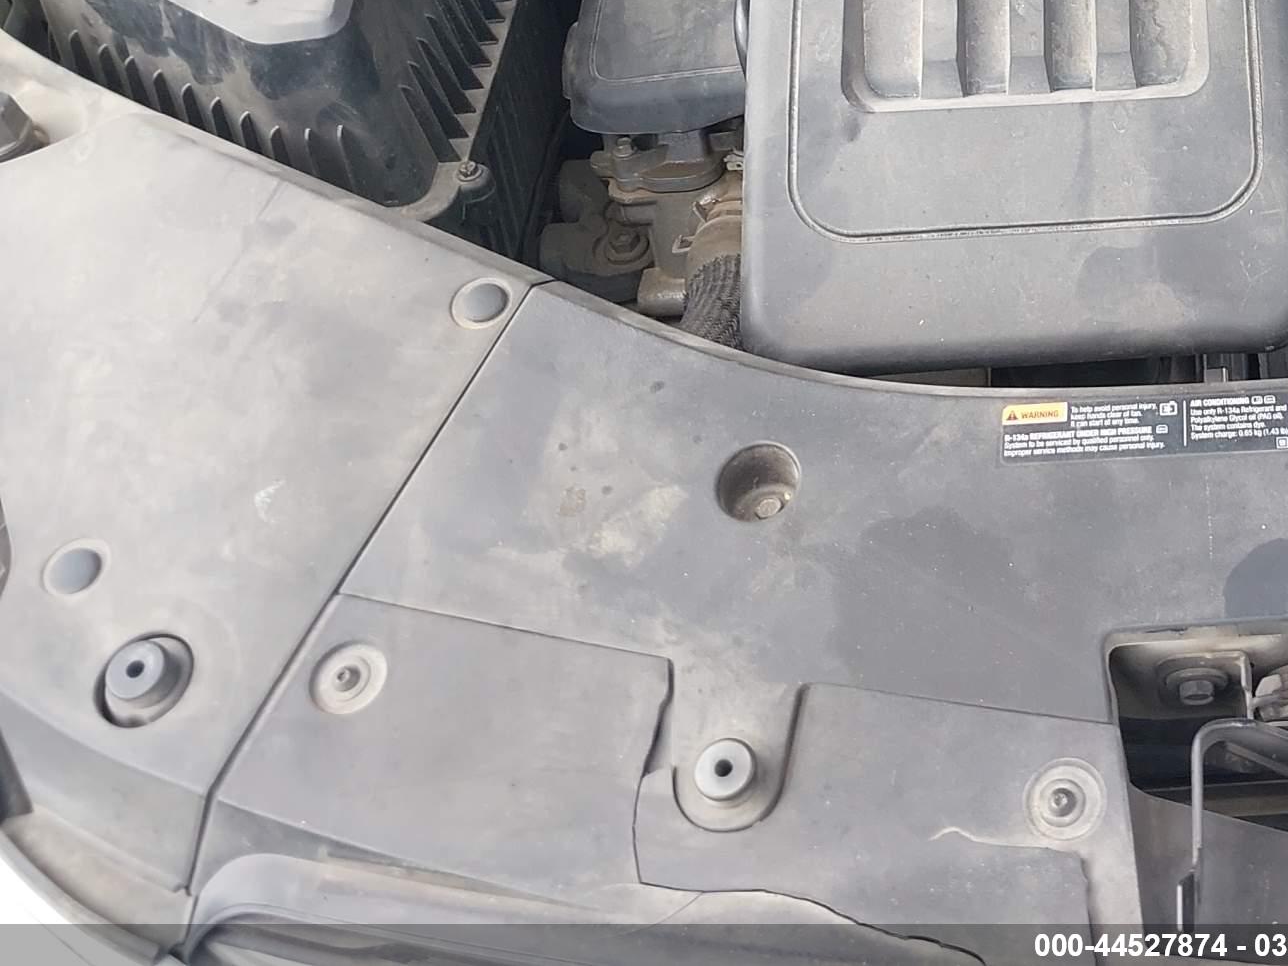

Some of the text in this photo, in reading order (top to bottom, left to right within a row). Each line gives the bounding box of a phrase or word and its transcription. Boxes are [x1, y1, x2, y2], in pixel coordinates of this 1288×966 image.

[1217, 406, 1240, 414] R-134a
[1021, 410, 1059, 420] WARNING
[1087, 412, 1106, 420] hands
[1204, 424, 1225, 432] system
[1005, 434, 1028, 442] R-134a
[1191, 432, 1213, 440] System
[1254, 429, 1262, 437] kg
[1119, 442, 1145, 451] personal
